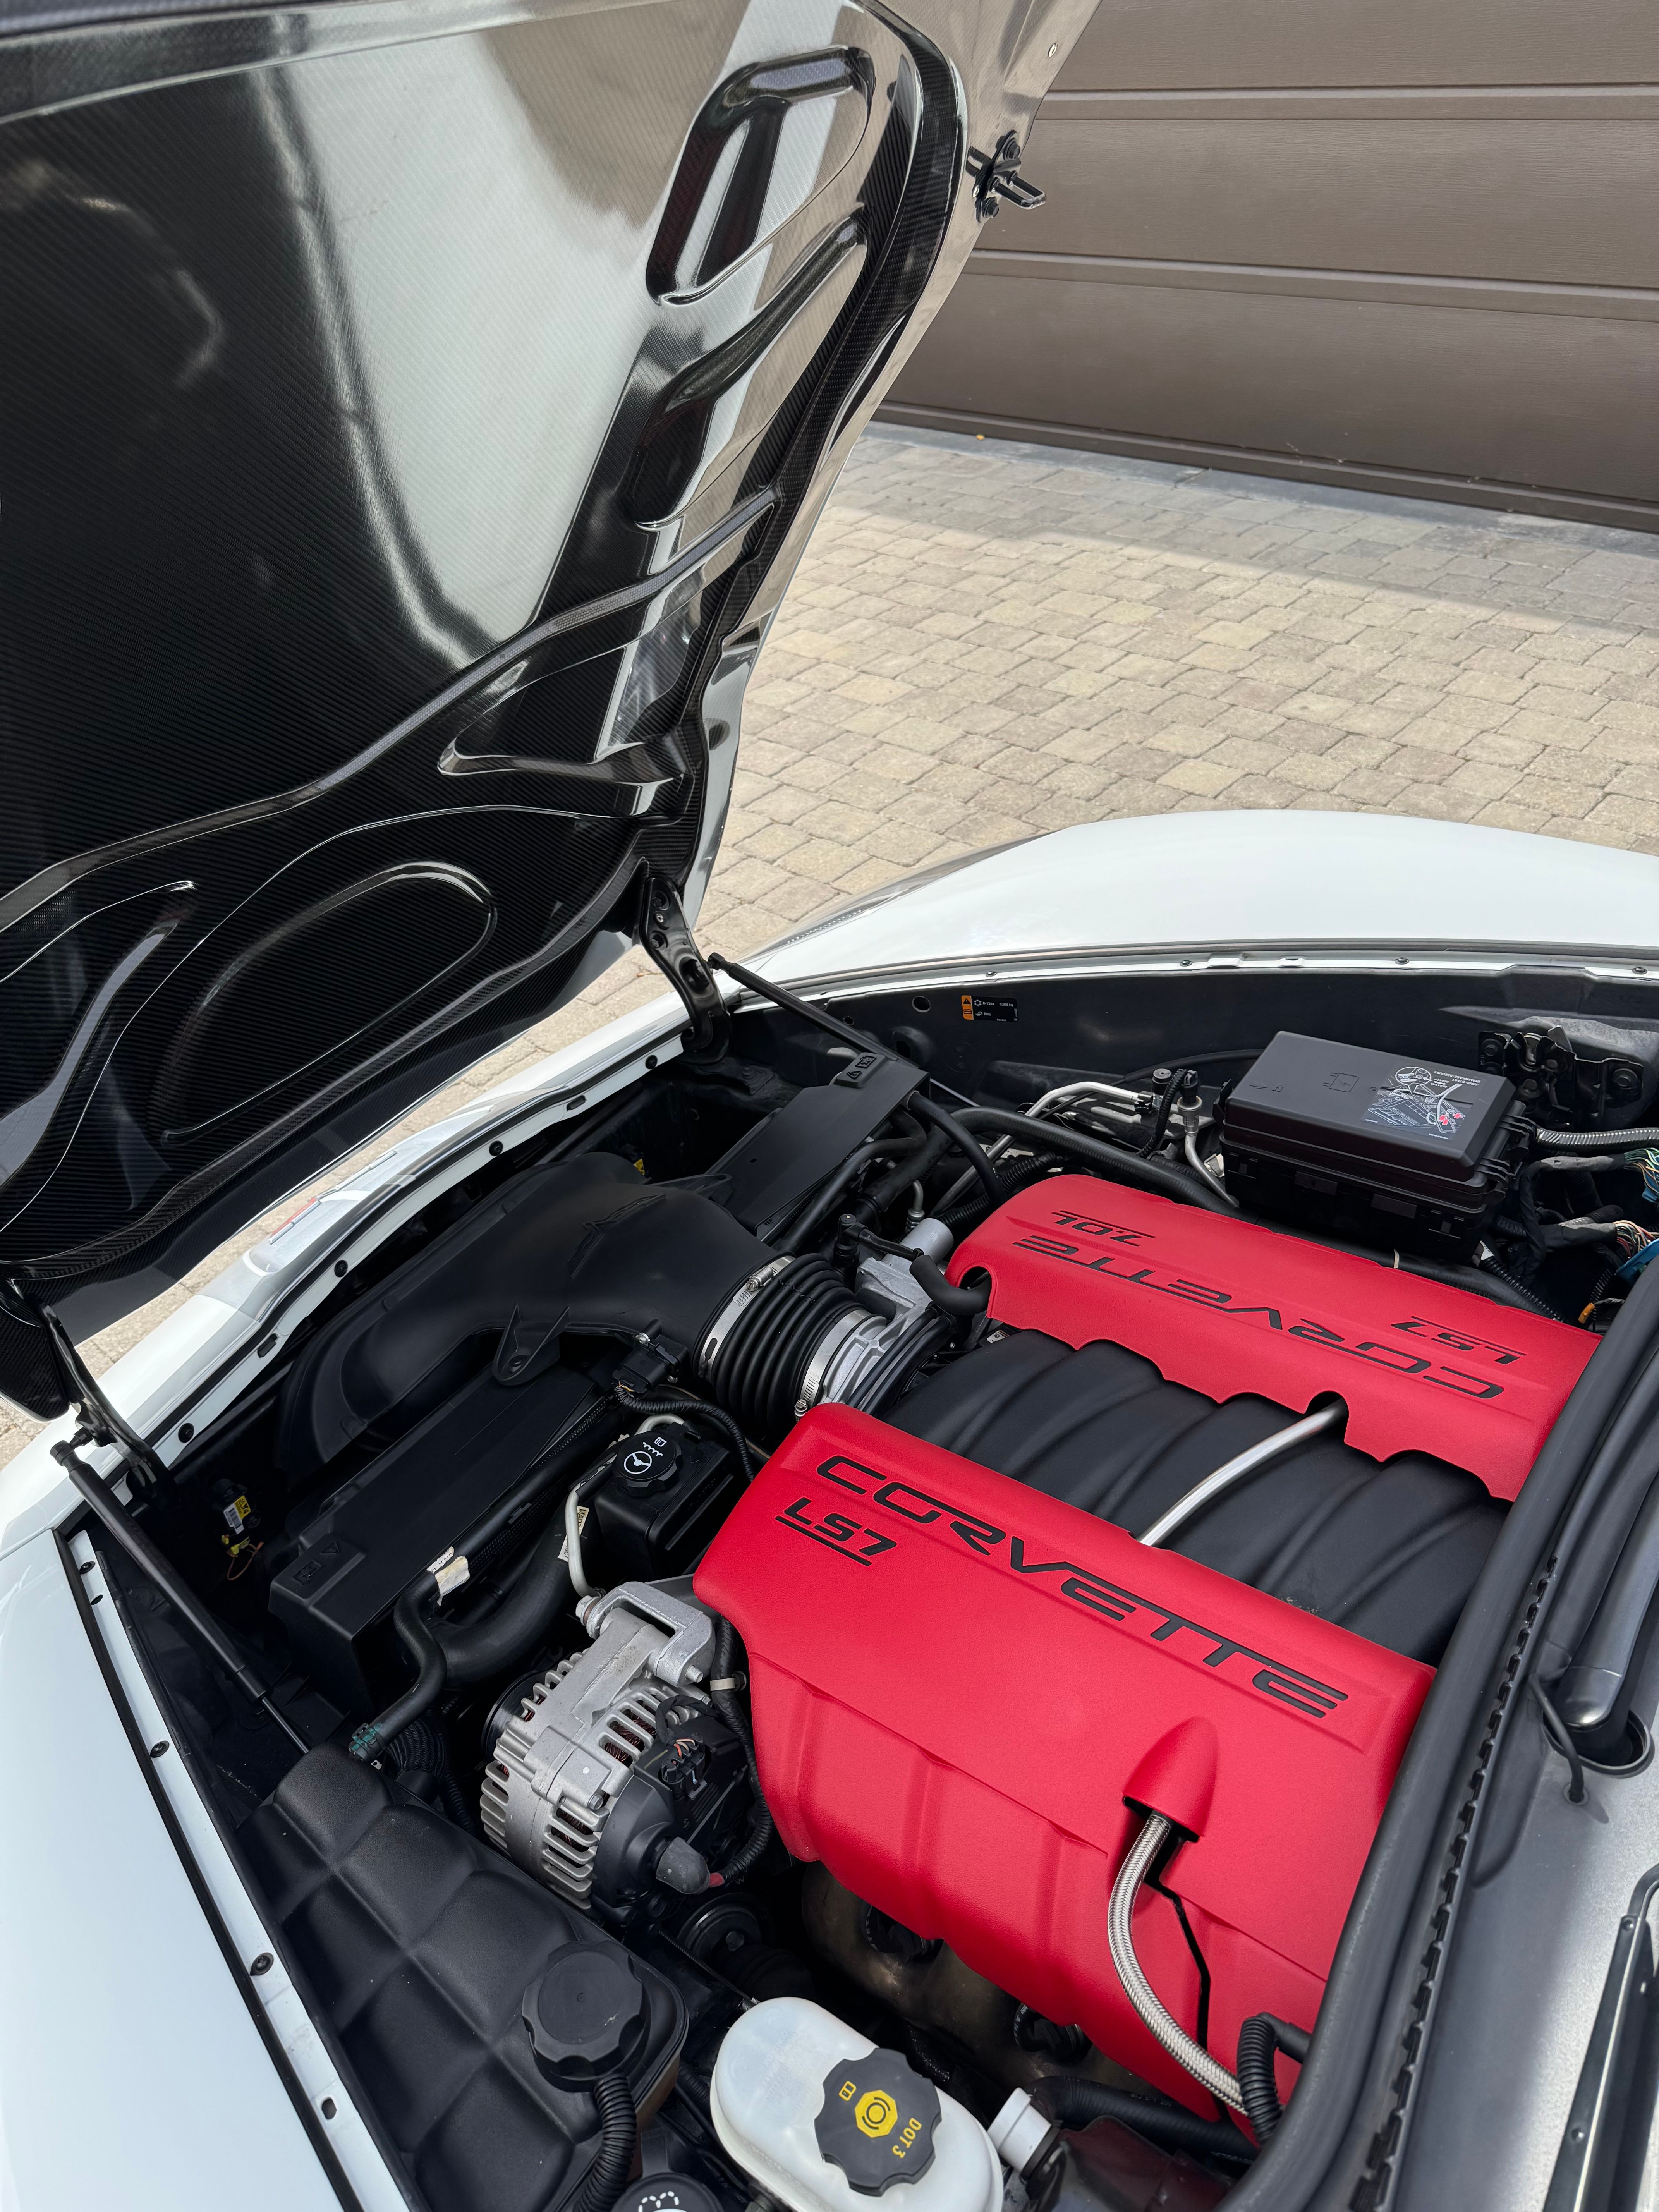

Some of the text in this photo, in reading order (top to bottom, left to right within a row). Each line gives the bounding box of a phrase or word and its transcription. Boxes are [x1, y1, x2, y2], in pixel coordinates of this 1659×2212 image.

[1013, 1235, 1504, 1399] CORVETTE
[1392, 1318, 1527, 1365] LS7
[781, 1497, 897, 1563] LS7
[817, 1456, 1348, 1718] CORVETTE
[892, 2118, 922, 2159] DOT 3
